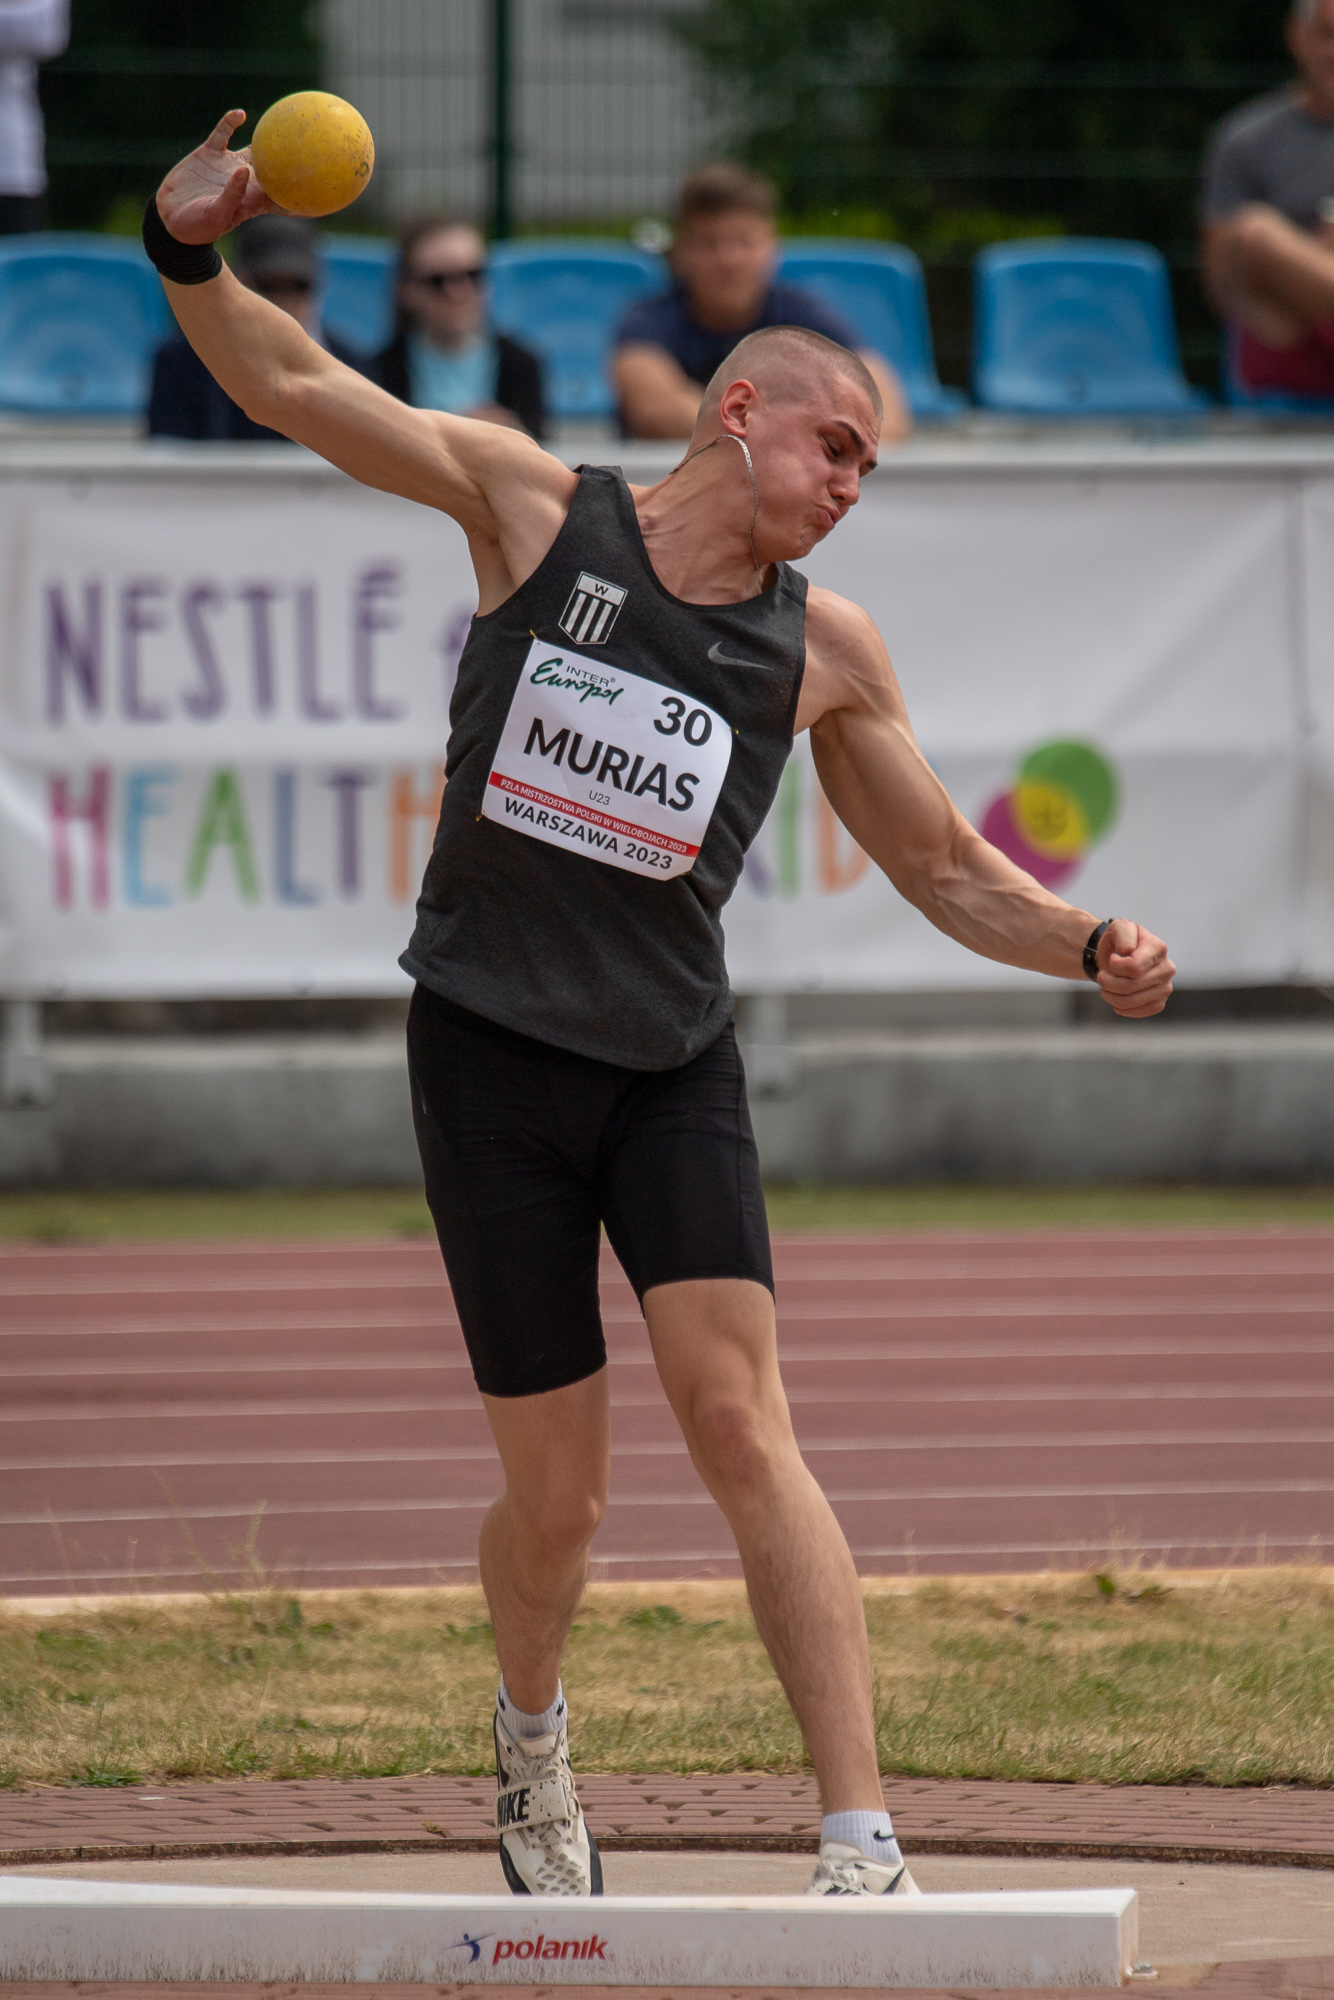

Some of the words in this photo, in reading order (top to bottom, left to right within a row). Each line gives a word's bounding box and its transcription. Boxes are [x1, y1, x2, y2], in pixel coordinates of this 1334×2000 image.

[594, 583, 609, 596] W
[44, 561, 405, 728] NESTLÉ
[530, 657, 624, 706] Europol
[653, 696, 713, 747] 30
[523, 716, 701, 812] MURIAS
[501, 779, 519, 792] PZLA
[520, 786, 575, 814] MISTRZOSTWA
[575, 807, 602, 824] POLSKI
[603, 817, 613, 827] W
[612, 821, 668, 847] WIELOBOJACH
[668, 841, 688, 853] 2023
[588, 790, 611, 806] U23
[505, 796, 618, 853] WARSZAWA
[623, 842, 673, 870] 2023
[492, 1934, 609, 1967] polanik
